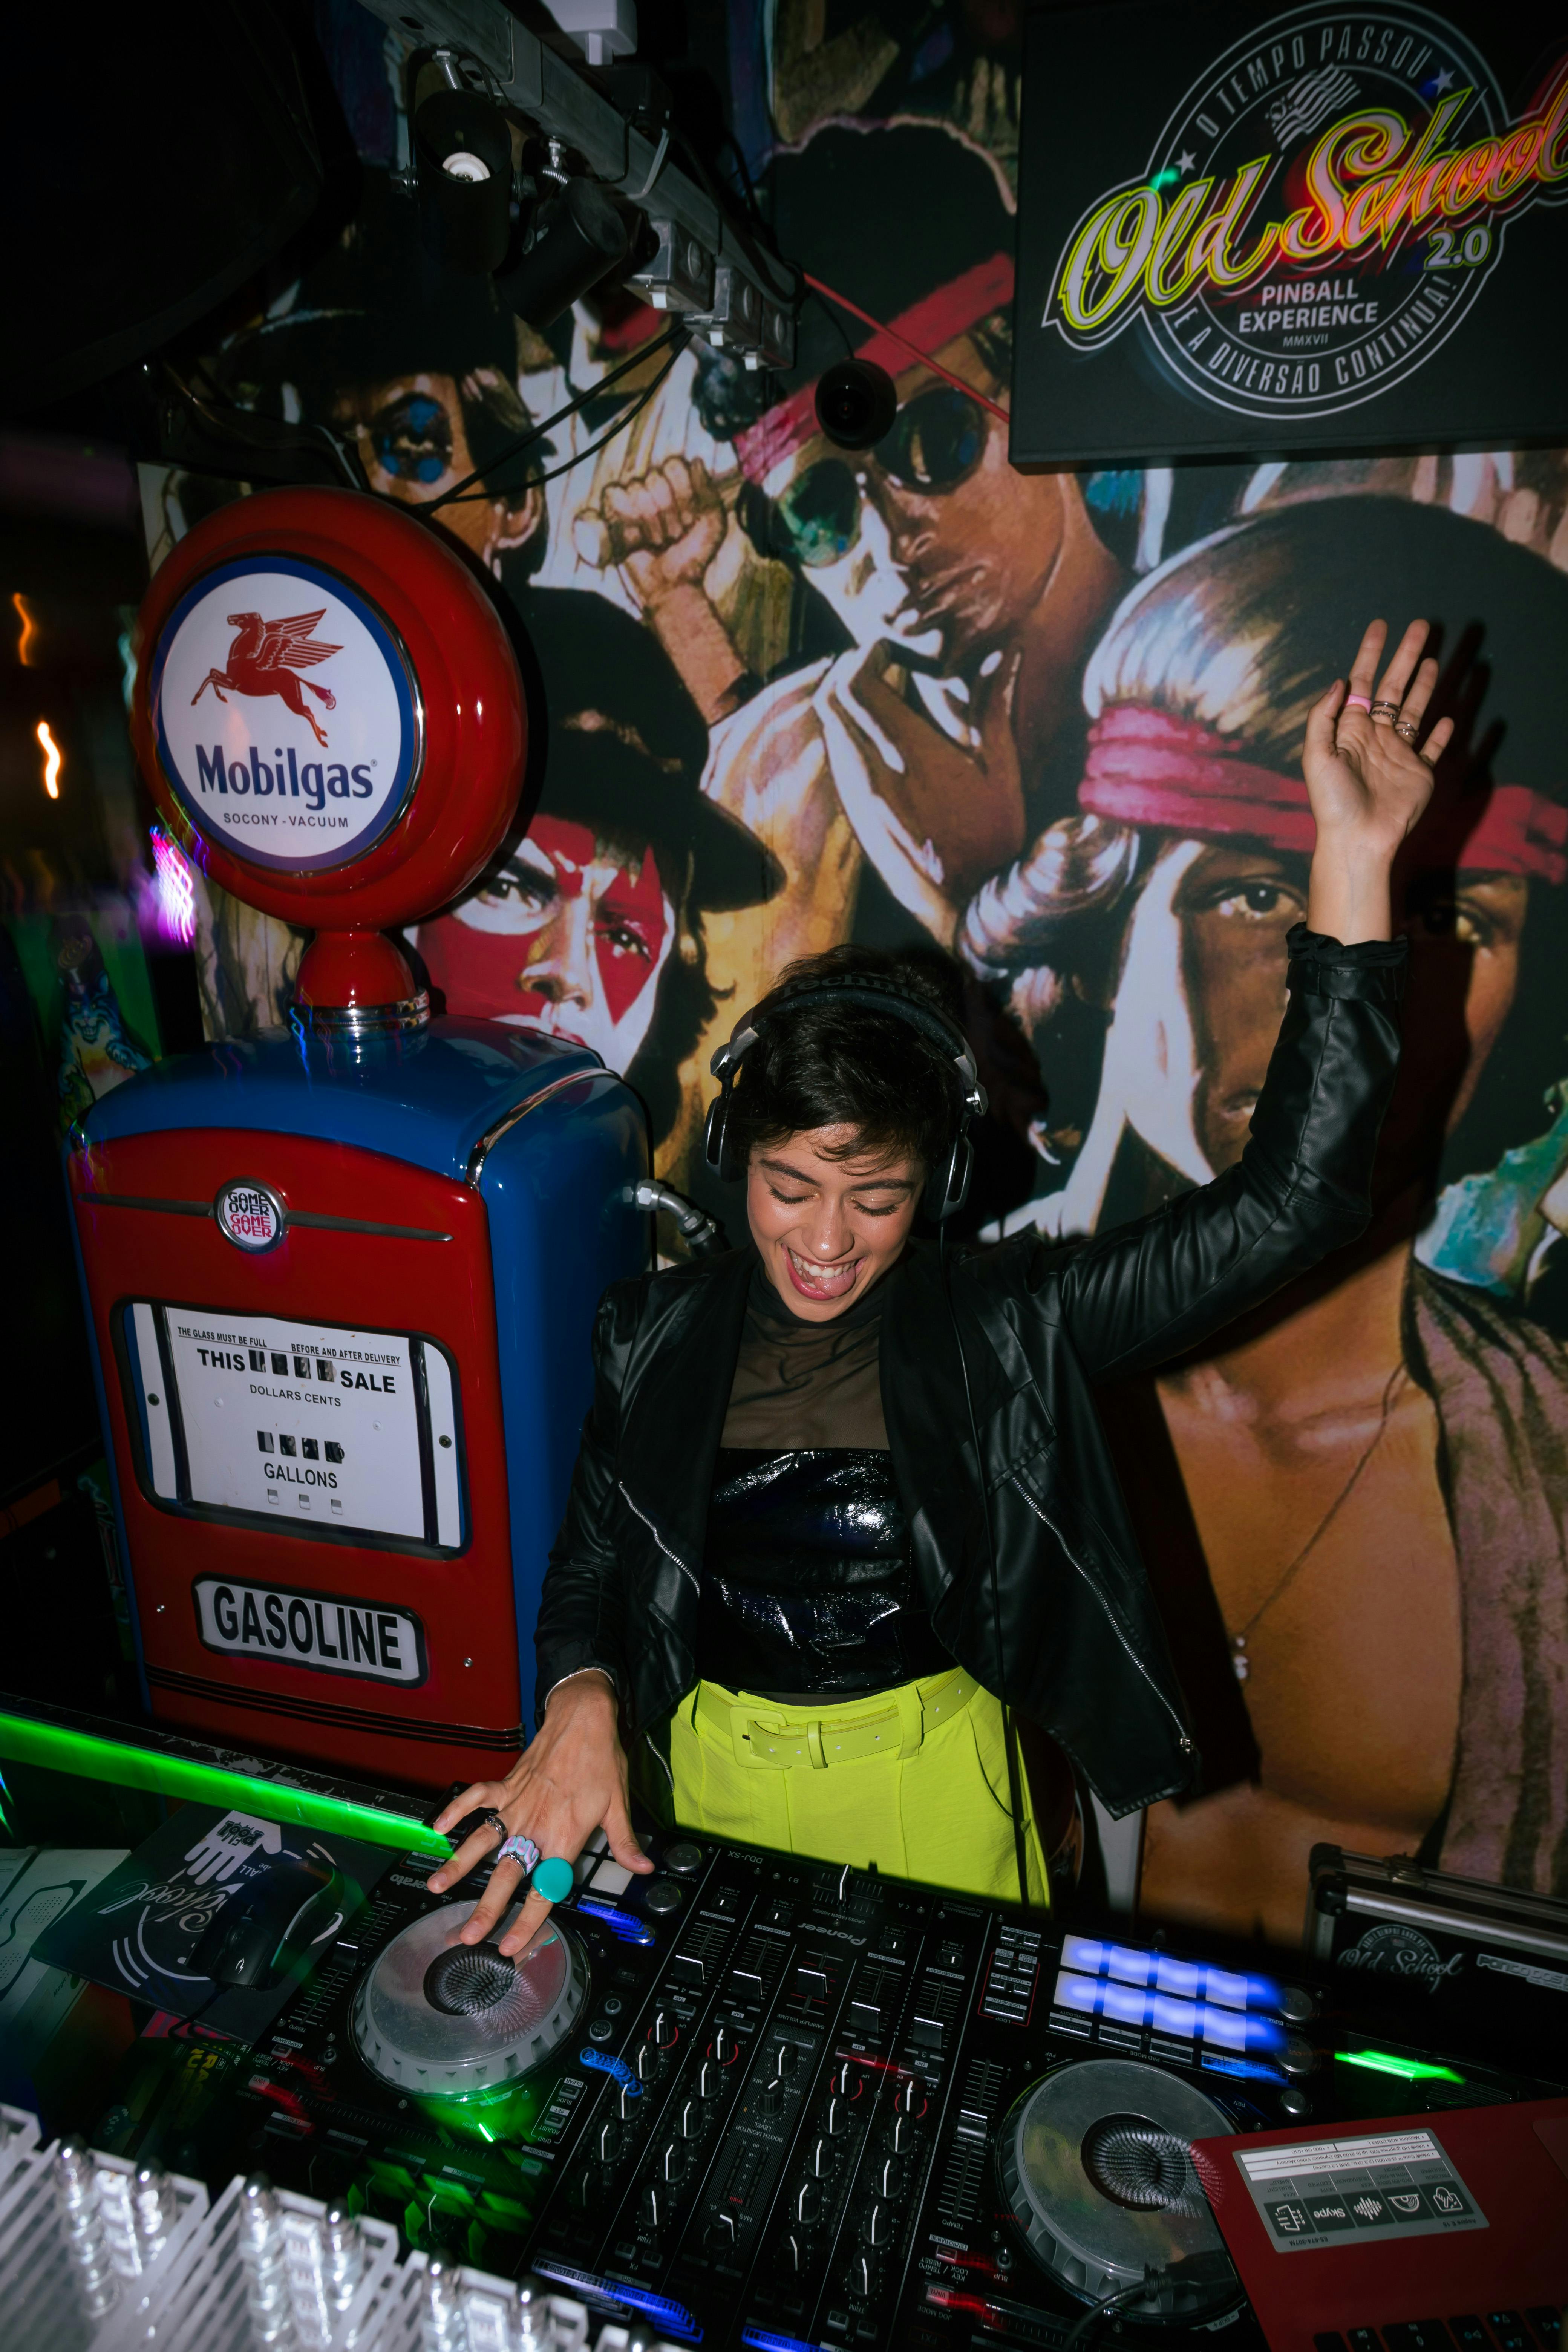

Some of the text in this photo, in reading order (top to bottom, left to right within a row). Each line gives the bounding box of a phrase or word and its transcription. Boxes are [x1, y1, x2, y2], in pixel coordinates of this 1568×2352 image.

[1199, 25, 1432, 137] O TEMPO PASSOU
[1058, 77, 1568, 330] Old School
[1424, 227, 1491, 270] 2.0
[1262, 280, 1359, 306] PINBALL
[1239, 303, 1378, 333] EXPERIENCE
[1174, 276, 1458, 394] E A DIVERSÃO CONTINUA!
[1283, 333, 1328, 347] MMXVII
[228, 1191, 268, 1205] GAME
[229, 1202, 269, 1216] OVER
[230, 1213, 271, 1227] GAME
[232, 1224, 272, 1237] OVER
[178, 1327, 267, 1348] THE GLASS MUST BE FULL
[291, 1343, 400, 1364] BEFORE AND AFTER DELIVERY
[197, 1348, 396, 1393] THIS SALE
[250, 1385, 341, 1406] DOLLARS CENTS
[264, 1462, 338, 1489] GALLONS
[213, 1585, 402, 1670] GASOLINE
[727, 1850, 763, 1864] DDJ-SX
[667, 1873, 697, 1882] PLAY/PAUSE
[812, 1908, 831, 1917] ASSIGN
[831, 1912, 847, 1920] FADER
[943, 1906, 980, 1918] PERFORMANCE
[1007, 1927, 1035, 1937] PARAMETER2
[1001, 1941, 1036, 1952] PARAMETER1
[777, 2014, 825, 2029] SAMPLER VOLUME
[1056, 2021, 1082, 2031] SAMPLER
[289, 2024, 306, 2033] TEMPO
[256, 2052, 273, 2061] RESET
[1129, 2050, 1147, 2060] MODE
[252, 2057, 270, 2066] TEMPO
[279, 2059, 294, 2068] LOCK
[566, 2078, 582, 2087] CLEAR
[556, 2097, 573, 2106] SLIDE
[538, 2125, 560, 2135] ADJUST
[754, 2122, 772, 2131] LEVEL
[735, 2125, 783, 2142] BOOTH MONITOR
[528, 2148, 548, 2158] REVERSE
[1313, 2207, 1345, 2218] Skype
[942, 2219, 964, 2230] TEMPO
[637, 2235, 651, 2244] TRIM
[931, 2236, 967, 2250] TEMPO RANGE
[919, 2257, 941, 2267] RESET
[918, 2263, 940, 2274] TEMPO
[950, 2265, 968, 2274] LOCK
[930, 2288, 946, 2298] VINYL
[848, 2304, 865, 2313] TRIM
[917, 2305, 952, 2321] JOG MODE
